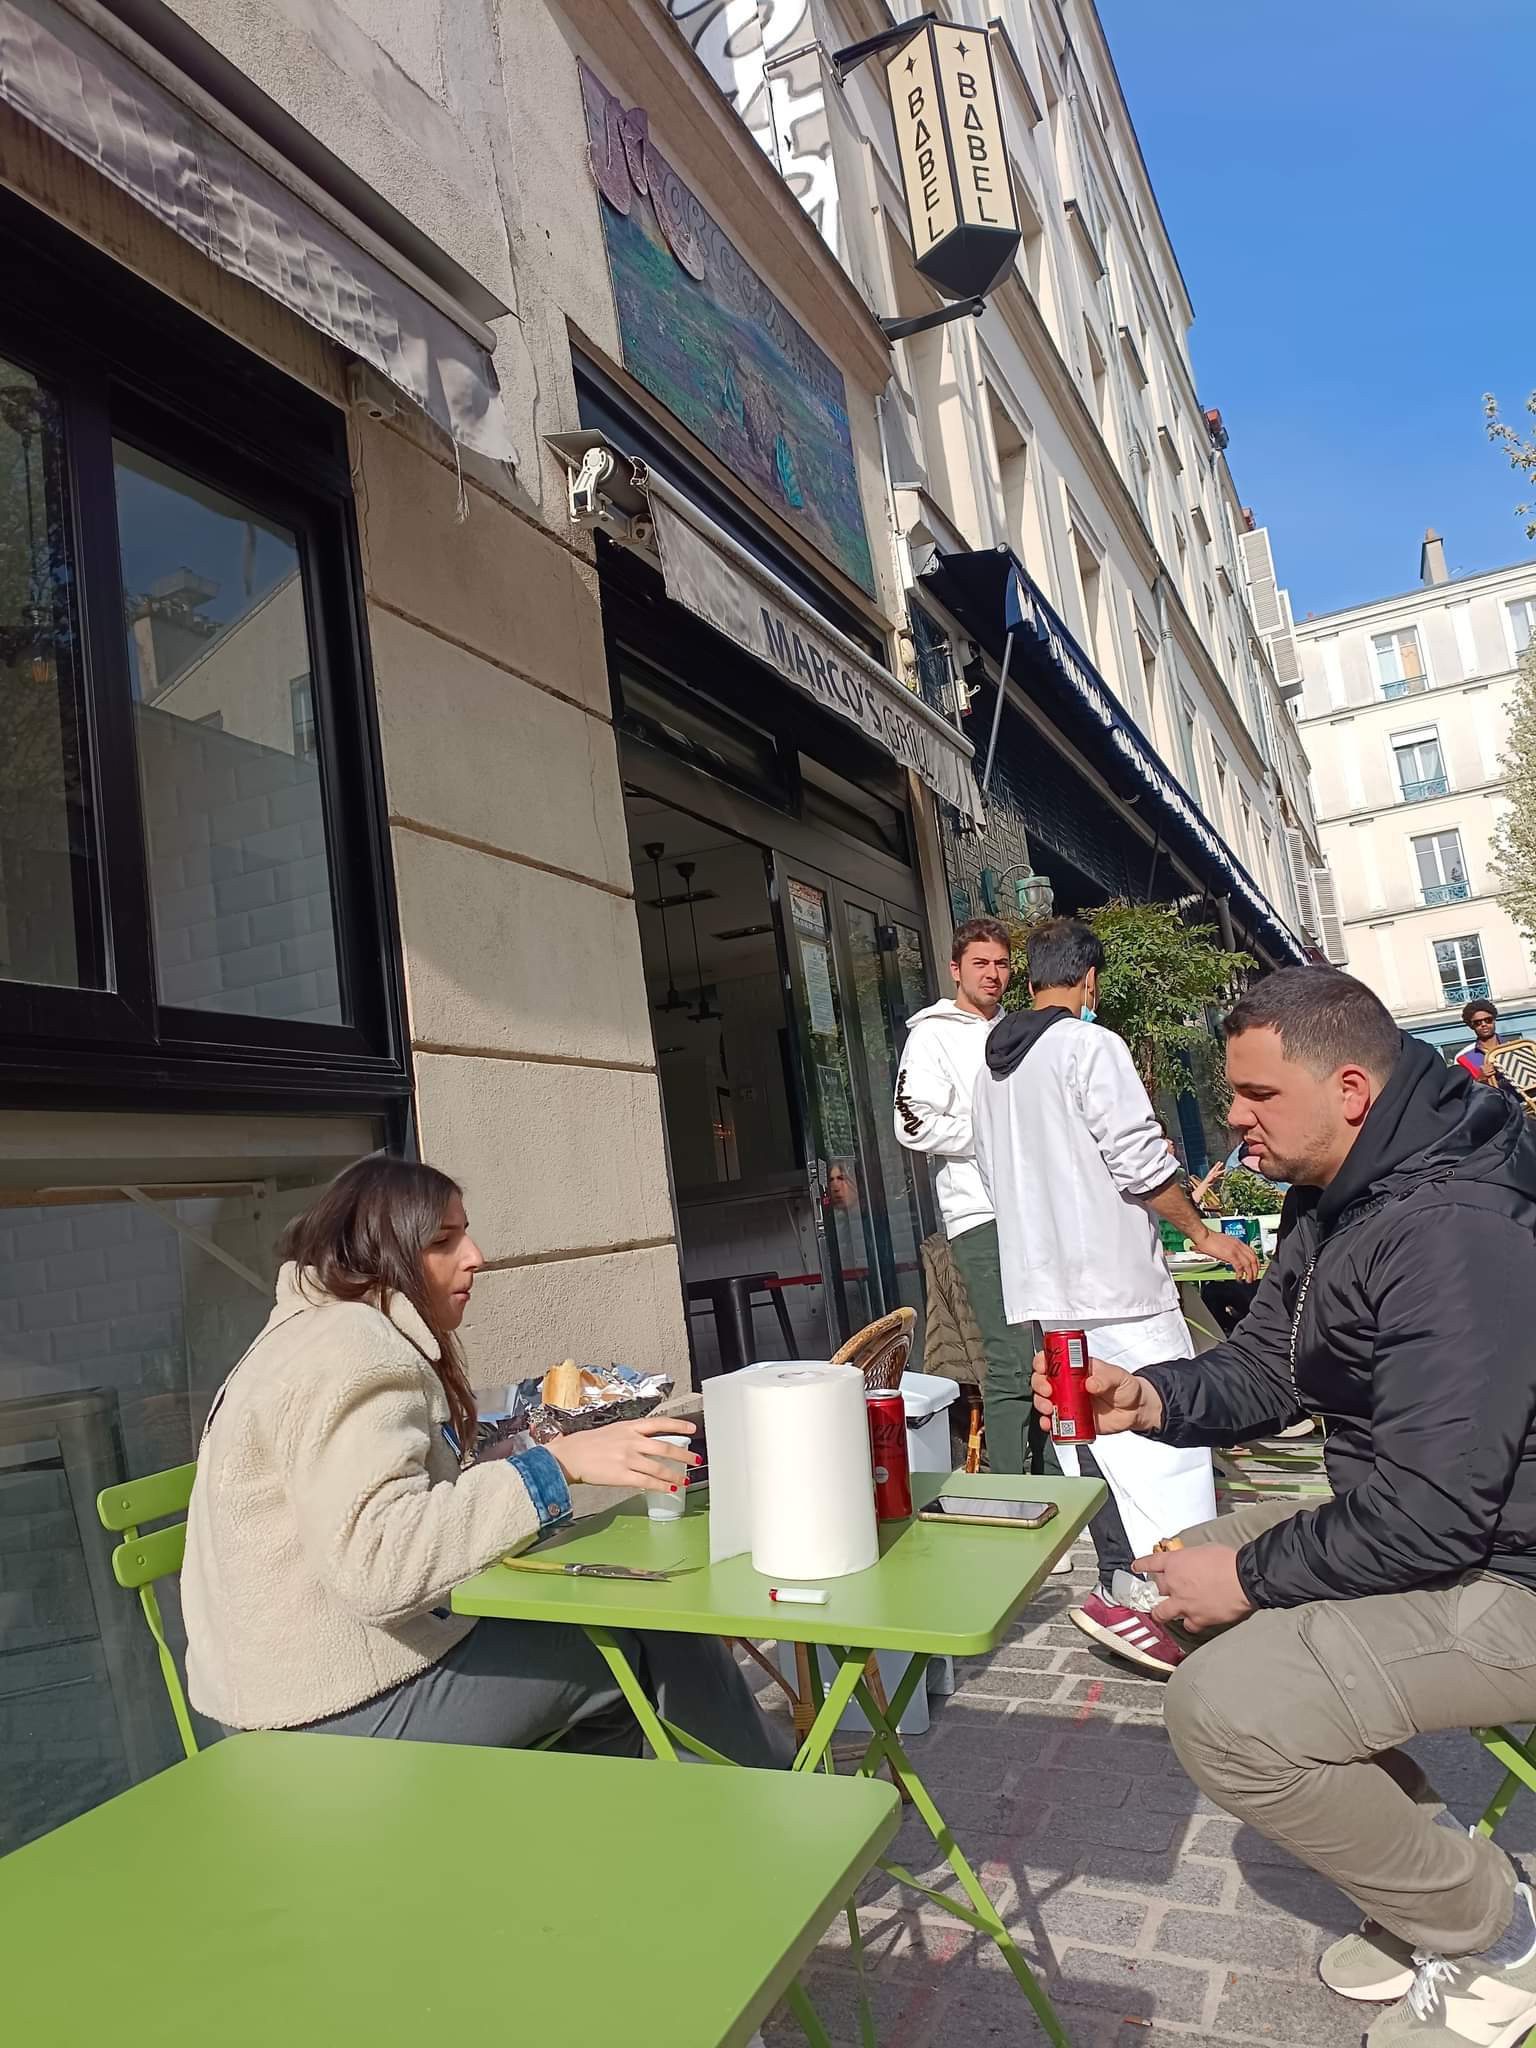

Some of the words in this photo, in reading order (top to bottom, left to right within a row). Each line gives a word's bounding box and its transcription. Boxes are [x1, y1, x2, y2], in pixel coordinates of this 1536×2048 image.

[908, 86, 945, 242] BABEL
[957, 71, 998, 223] BABEL
[760, 606, 882, 733] MARCO'S
[882, 704, 935, 781] GRILL
